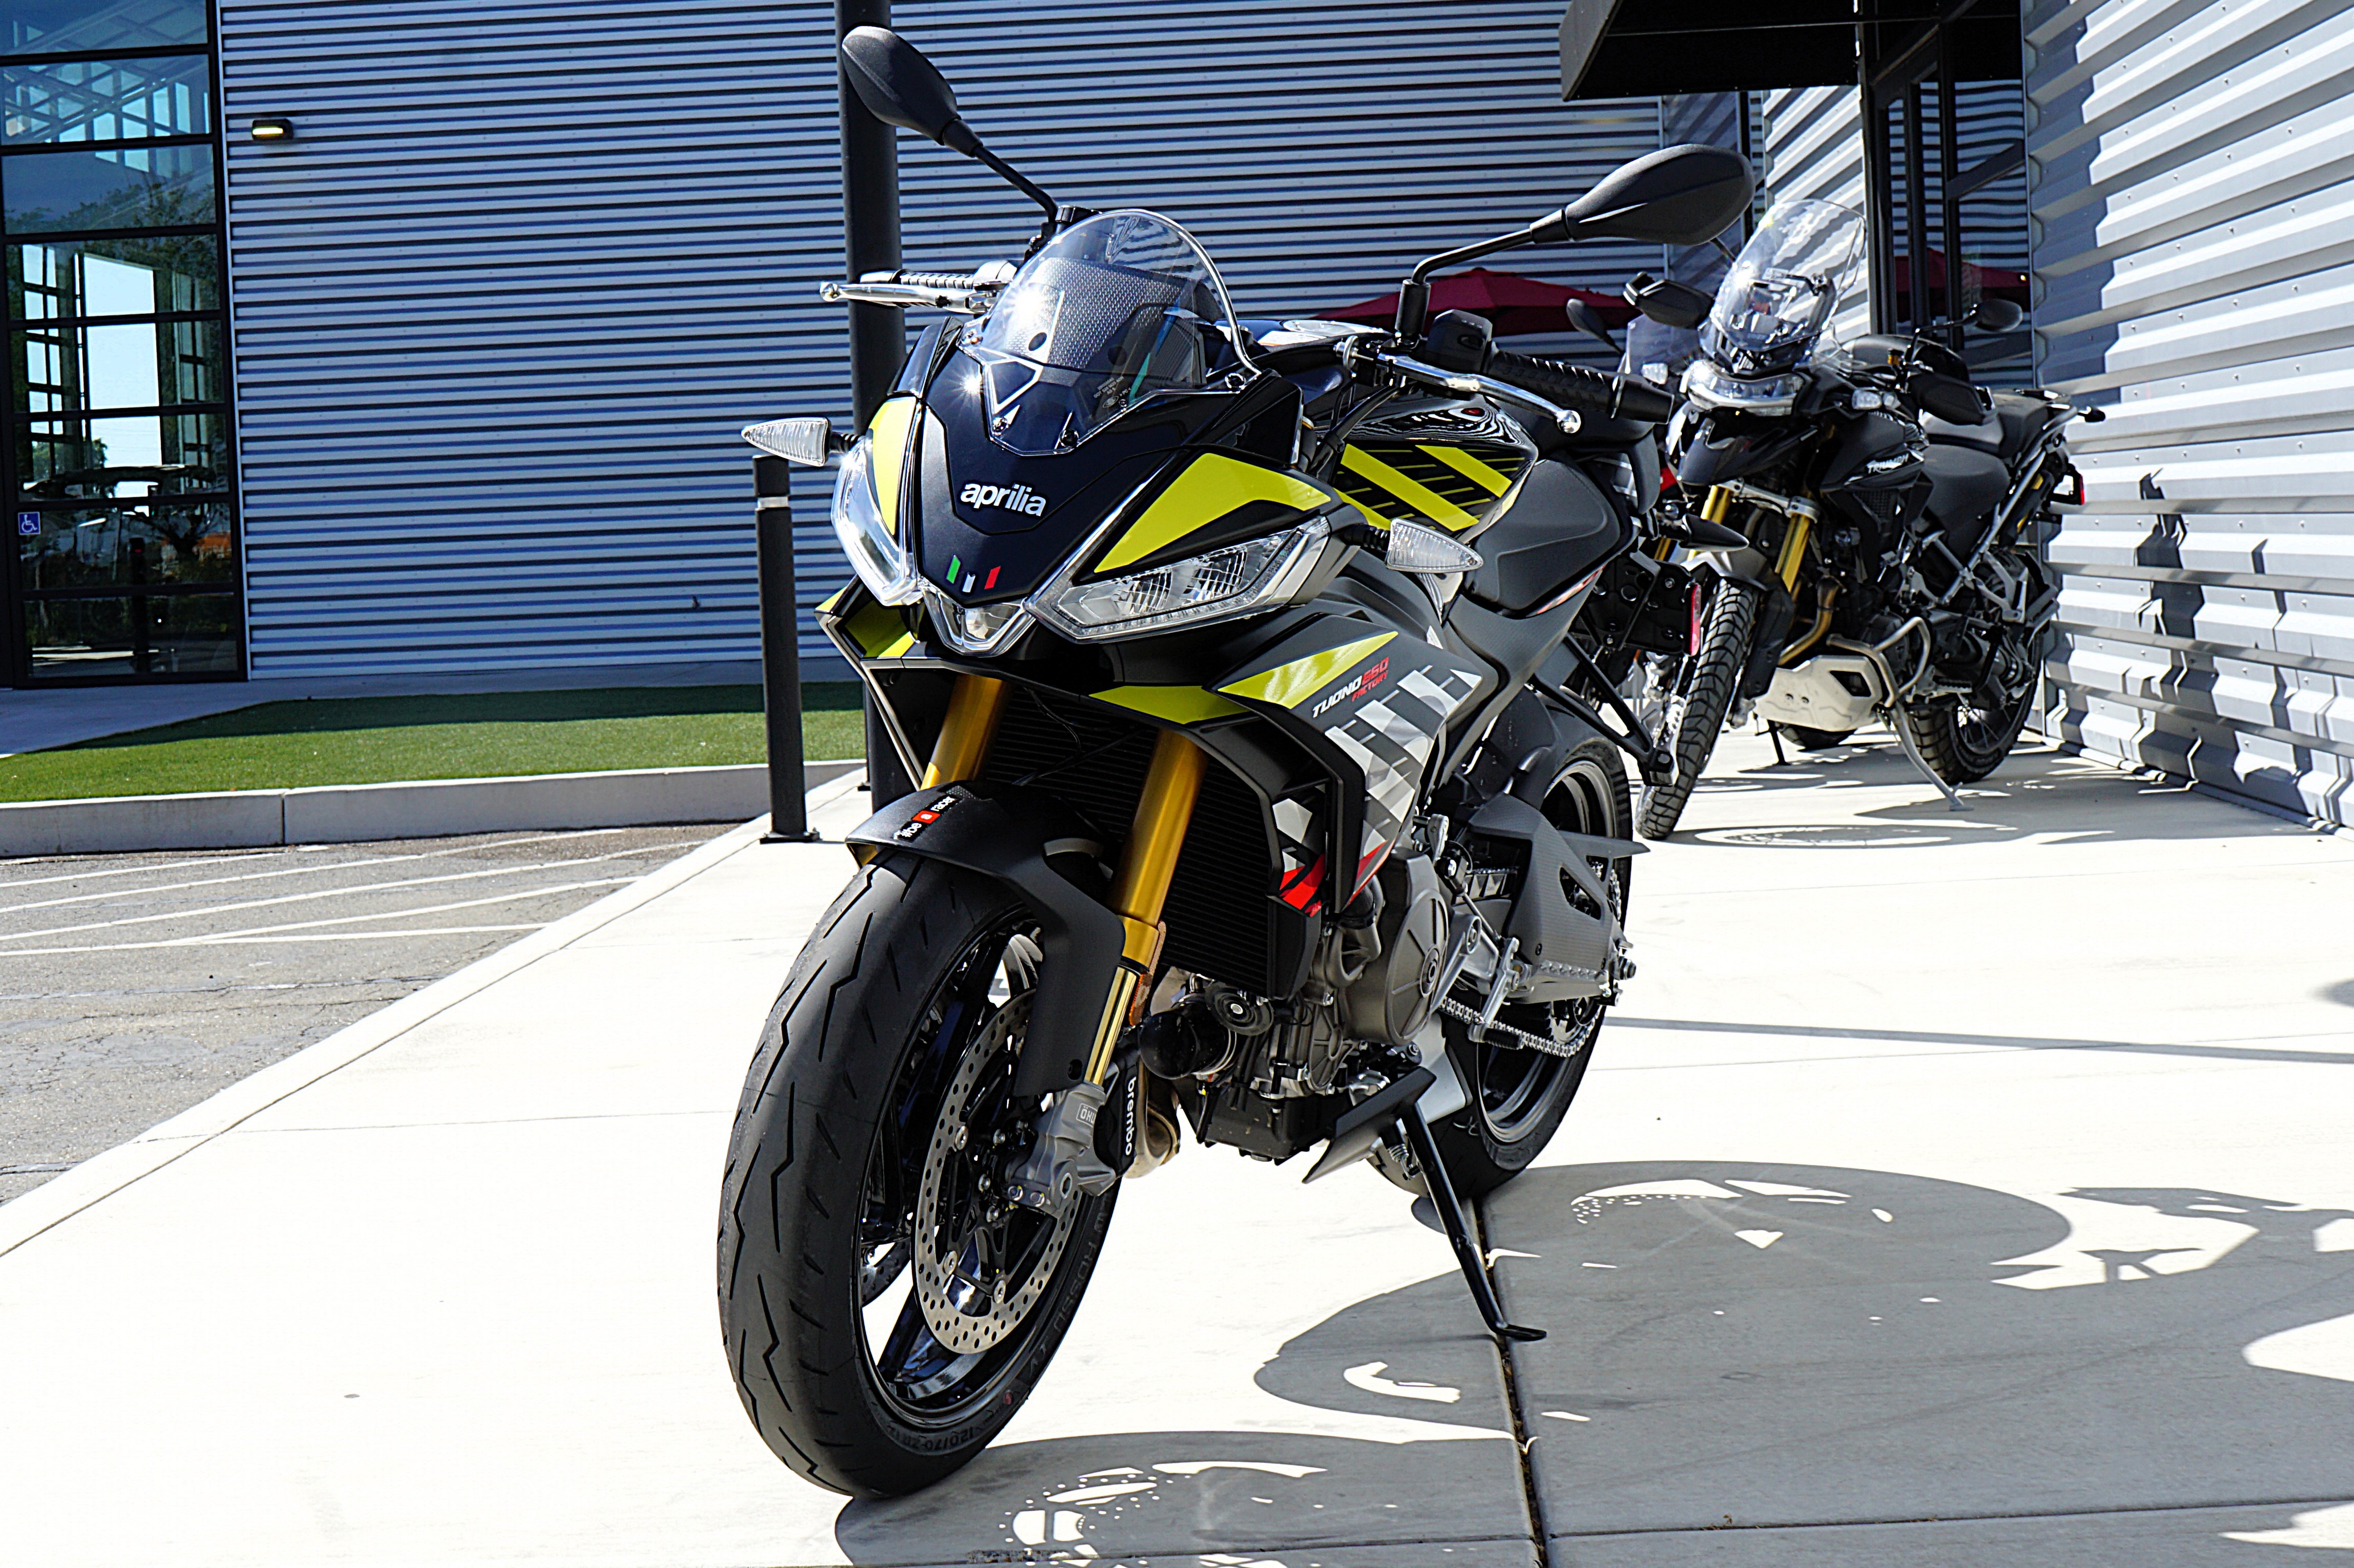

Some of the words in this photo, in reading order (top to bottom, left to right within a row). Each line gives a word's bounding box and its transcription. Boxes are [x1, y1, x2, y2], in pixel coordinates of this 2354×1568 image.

[960, 483, 1046, 517] aprilia
[1312, 675, 1362, 718] TUONO
[1361, 656, 1389, 686] 660
[1352, 670, 1389, 703] FACTORY
[930, 796, 955, 812] racer
[1126, 1076, 1137, 1156] brembo
